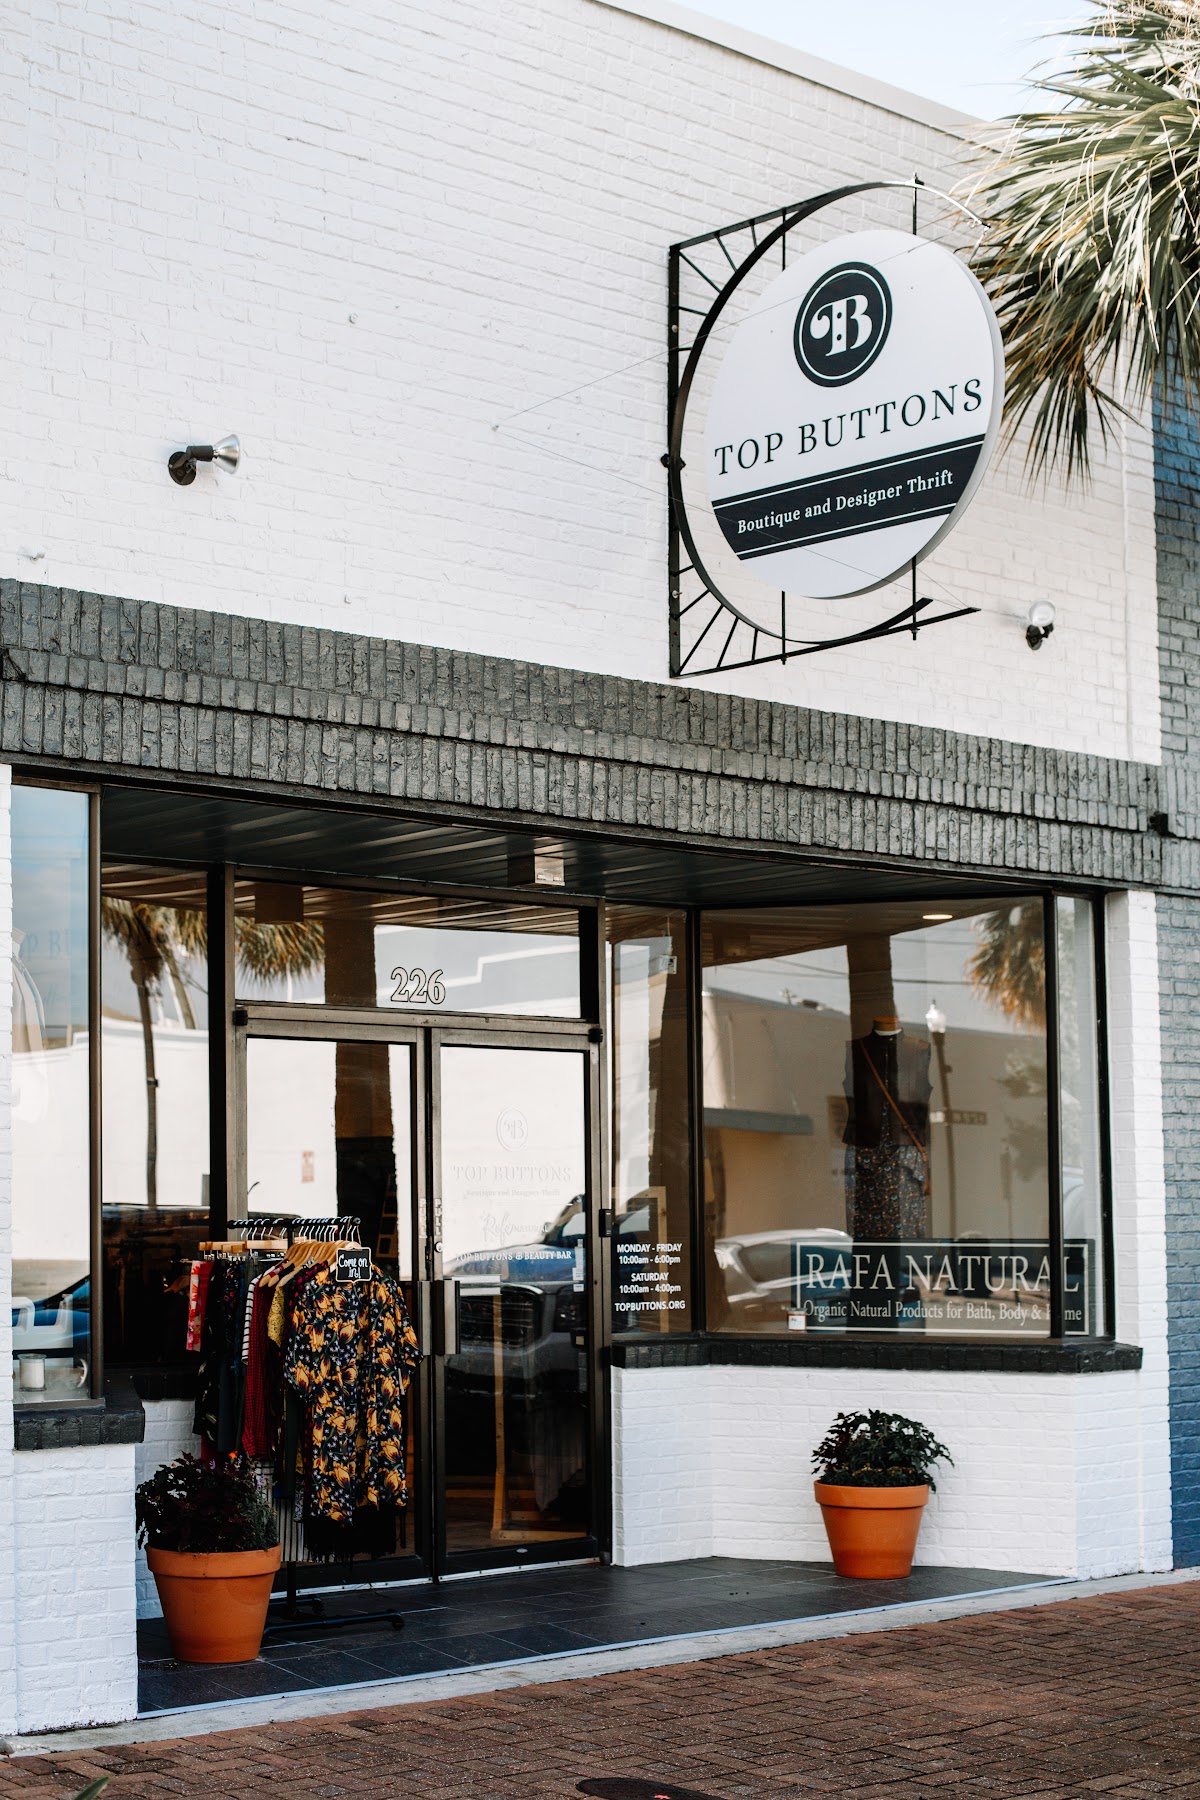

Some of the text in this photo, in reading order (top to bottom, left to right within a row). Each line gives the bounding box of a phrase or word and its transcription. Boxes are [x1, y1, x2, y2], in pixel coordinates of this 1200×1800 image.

[714, 378, 983, 476] TOP BUTTONS
[737, 469, 954, 535] Boutique and Designer Thrift
[390, 966, 446, 1005] 226
[453, 1165, 572, 1183] TOP BUTTONS
[617, 1244, 651, 1253] MONDAY
[656, 1243, 682, 1252] FRIDAY
[338, 1254, 368, 1268] Come on
[474, 1252, 513, 1261] BUTTONS
[524, 1251, 554, 1260] BEAUTY
[556, 1250, 572, 1260] BAR
[619, 1256, 649, 1265] 10:00am
[654, 1255, 681, 1265] 6:00pm
[348, 1267, 361, 1278] in!
[631, 1272, 669, 1282] SATURDAY
[805, 1253, 1080, 1293] RAFA NATURAL
[619, 1285, 649, 1294] 10:00am
[655, 1284, 681, 1294] 4:00pm
[614, 1300, 686, 1311] TOPBUTTONS.ORG
[803, 1299, 847, 1323] Organic
[850, 1300, 892, 1318] Natural
[895, 1300, 943, 1318] Products
[946, 1301, 963, 1319] for
[966, 1302, 996, 1321] Bath,
[999, 1301, 1028, 1326] Body
[1031, 1304, 1042, 1320] &
